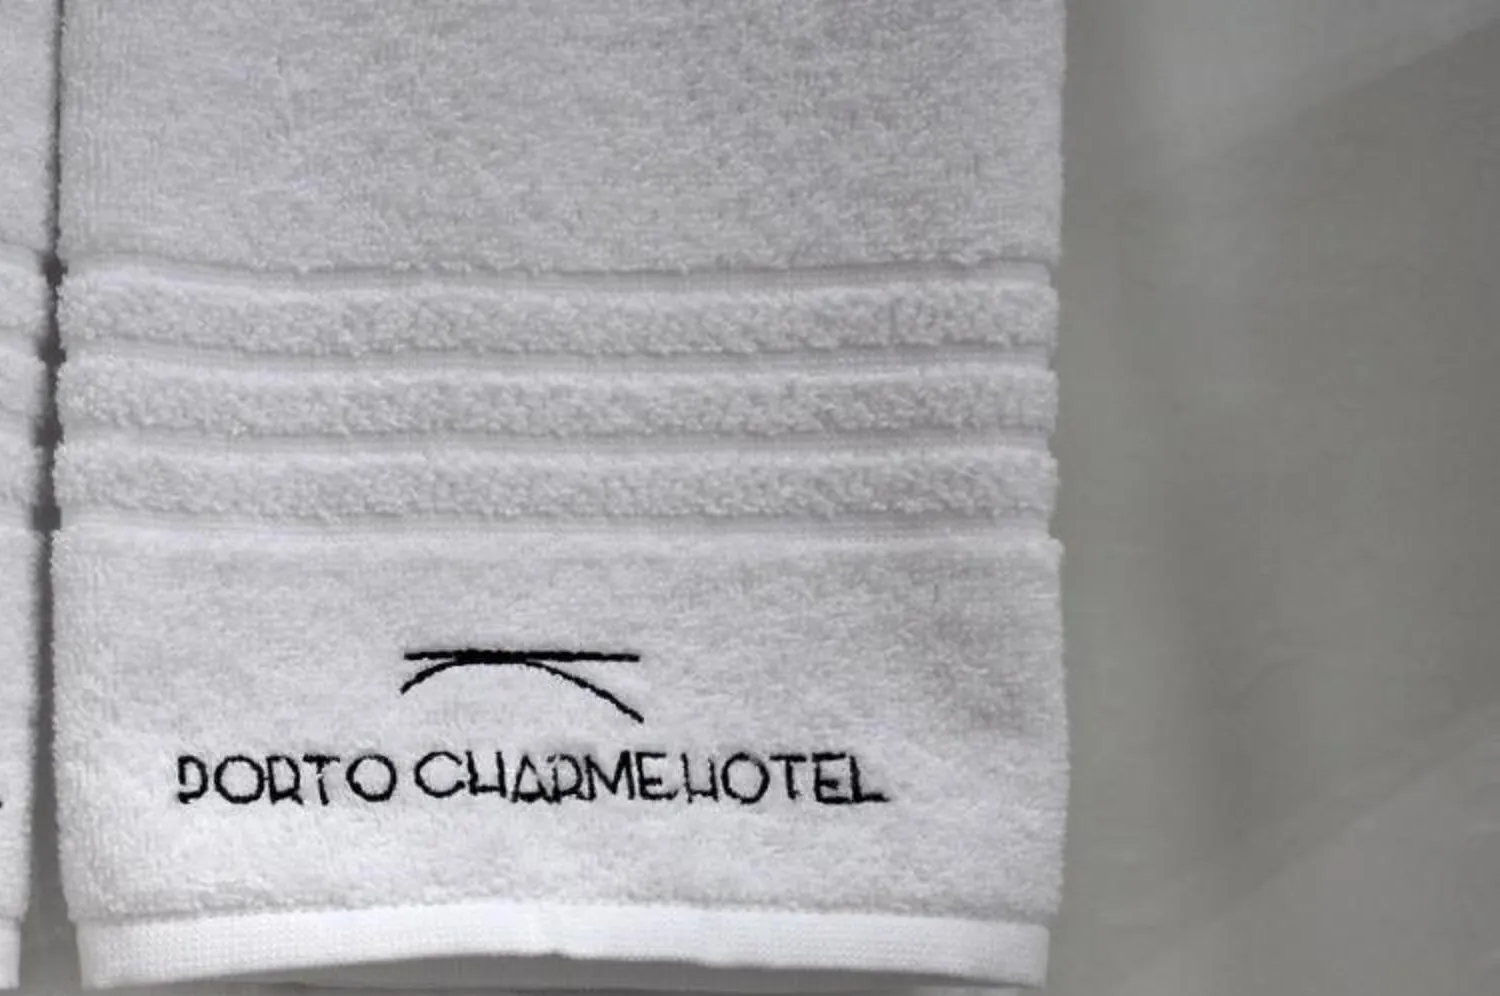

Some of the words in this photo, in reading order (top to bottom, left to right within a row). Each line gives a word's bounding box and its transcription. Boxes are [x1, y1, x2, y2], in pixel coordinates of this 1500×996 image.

[177, 753, 398, 805] PORTO
[413, 750, 678, 804] CHARME
[680, 751, 890, 804] HOTEL
